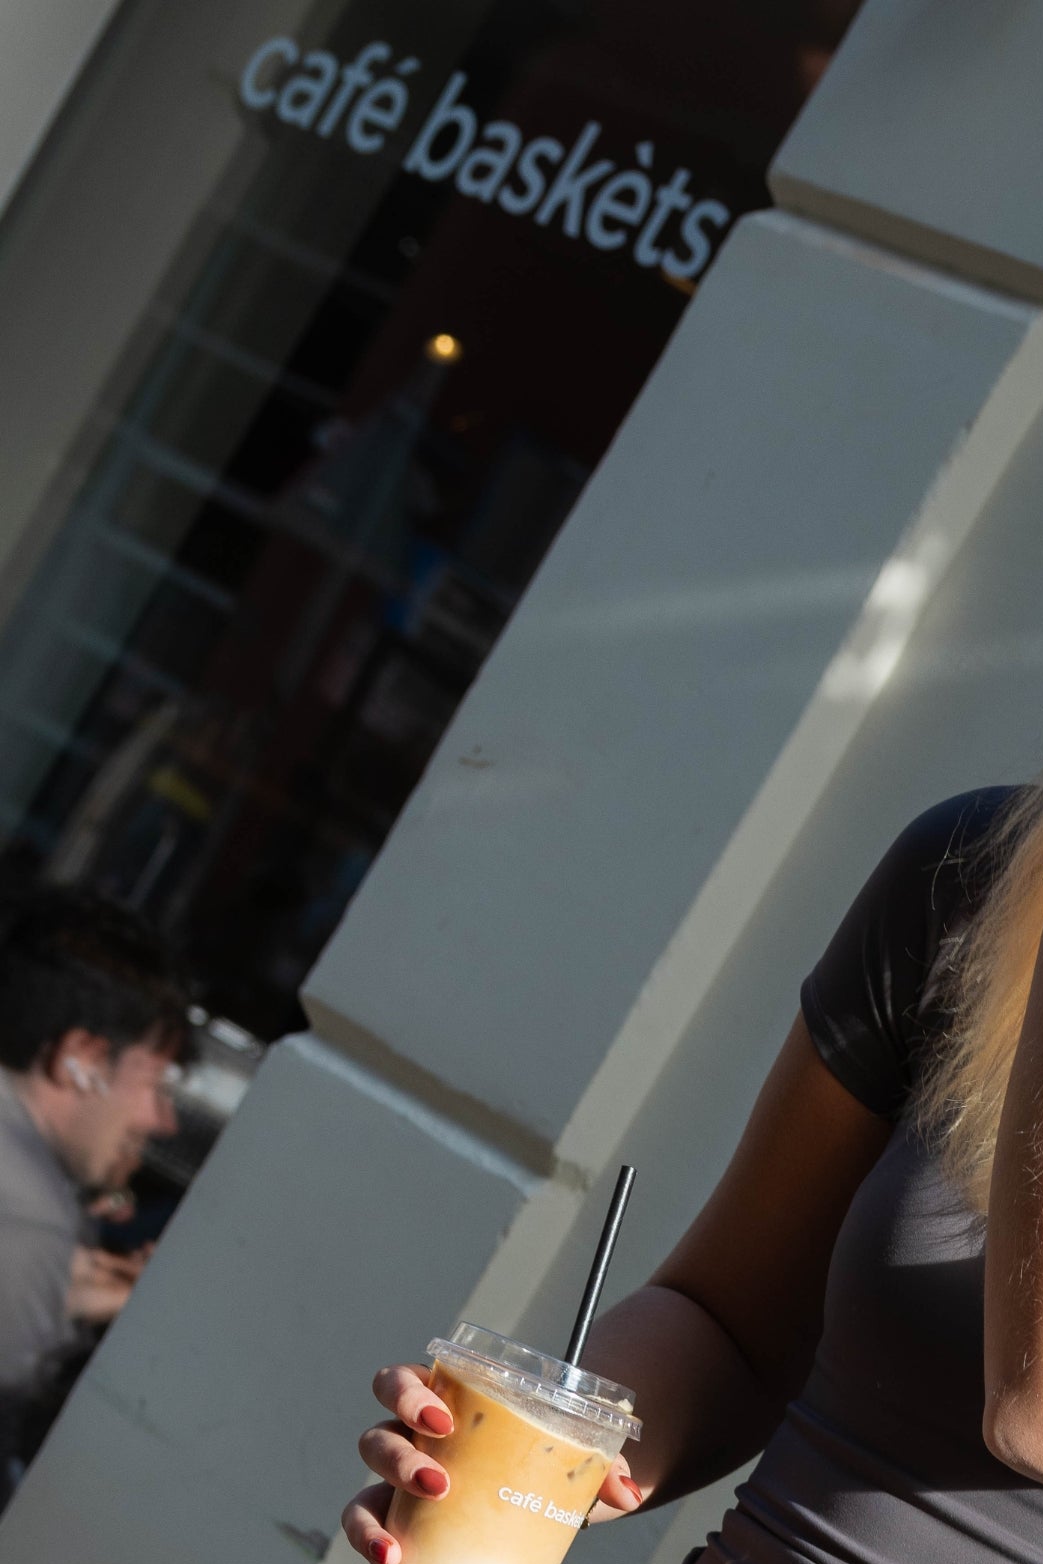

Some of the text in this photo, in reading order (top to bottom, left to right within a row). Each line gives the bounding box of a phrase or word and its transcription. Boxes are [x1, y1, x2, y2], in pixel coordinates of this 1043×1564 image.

[240, 36, 731, 280] café baskèts
[498, 1487, 543, 1513] café
